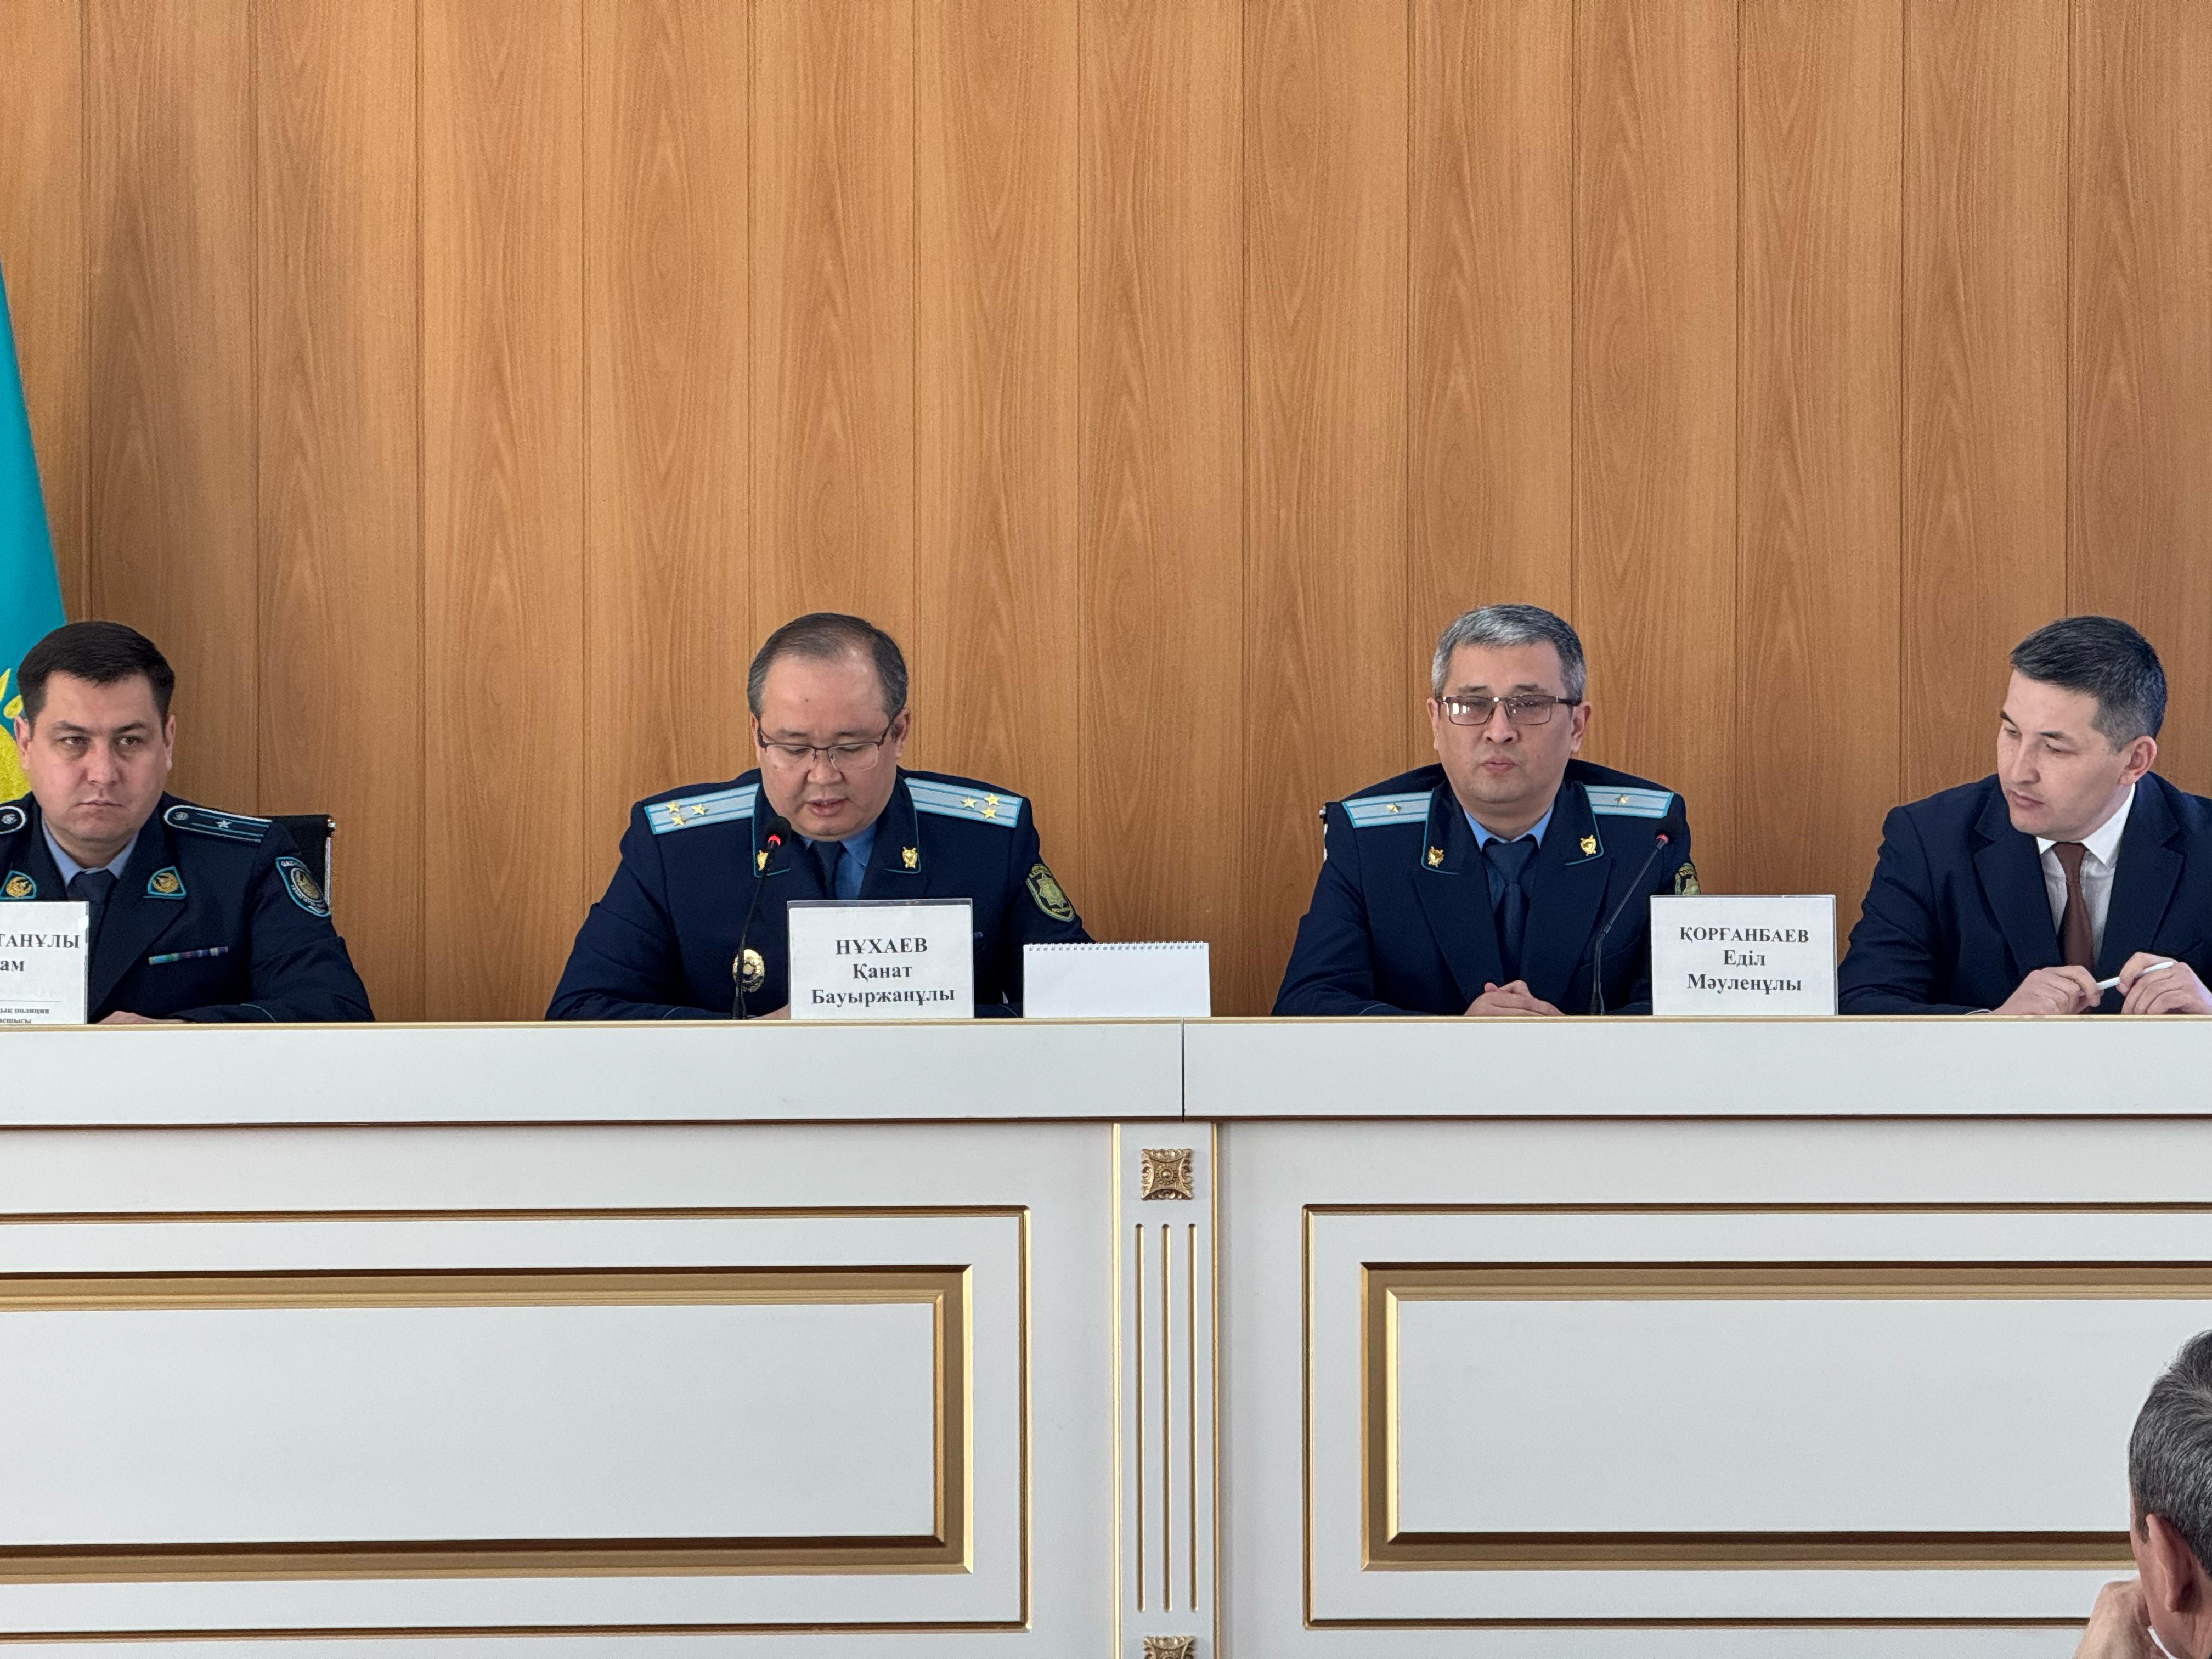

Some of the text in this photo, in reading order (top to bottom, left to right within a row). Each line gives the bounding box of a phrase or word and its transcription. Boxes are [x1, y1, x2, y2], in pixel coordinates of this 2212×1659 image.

[1679, 927, 1809, 943] ҚОРҒАНБАЕВ
[835, 938, 927, 955] НҰХАЕВ
[1723, 950, 1765, 967] Еділ
[853, 963, 912, 981] Қанат
[1687, 973, 1802, 995] Мәуленұлы
[811, 989, 955, 1007] Бауыржанұлы
